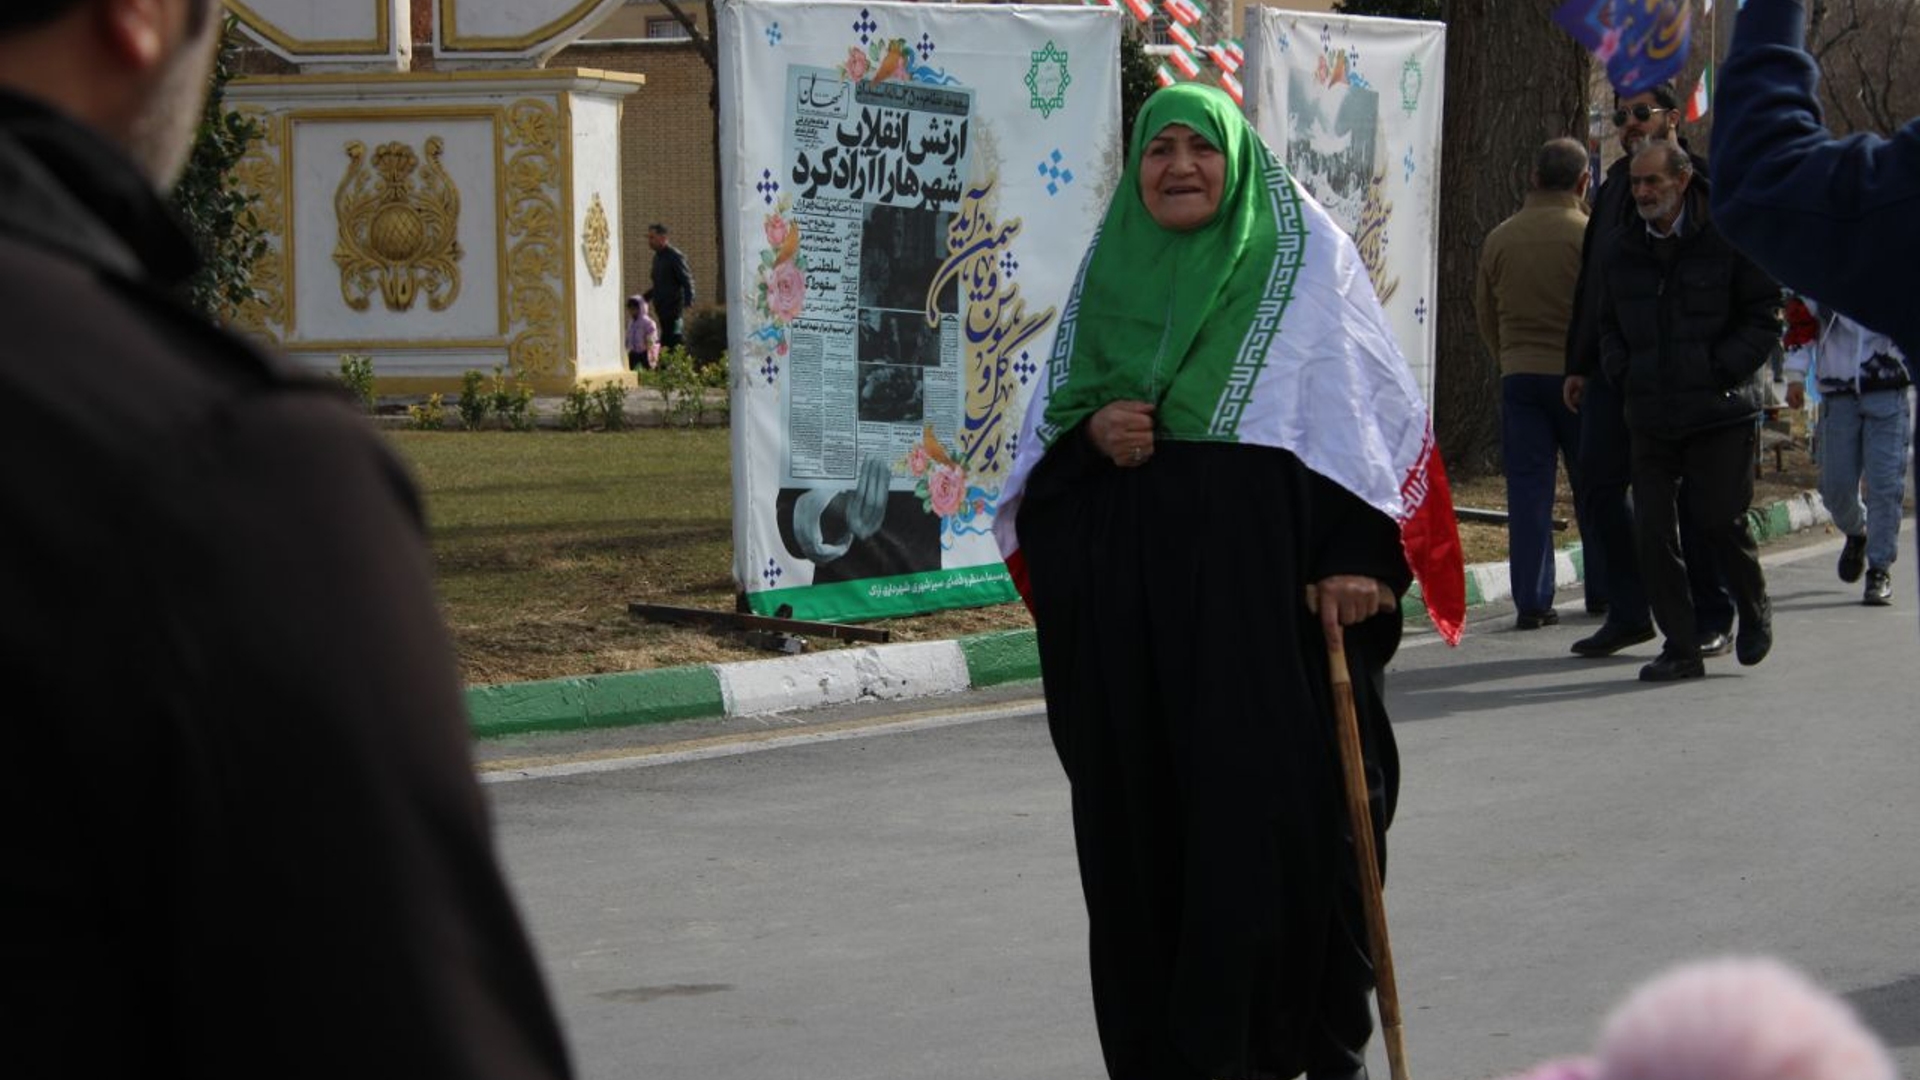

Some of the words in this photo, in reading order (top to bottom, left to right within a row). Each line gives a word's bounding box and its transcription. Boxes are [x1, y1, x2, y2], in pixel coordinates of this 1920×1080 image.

[836, 106, 910, 153] انقلاب
[906, 117, 968, 165] ارتش
[792, 146, 838, 199] کرد
[833, 147, 882, 199] آزاد
